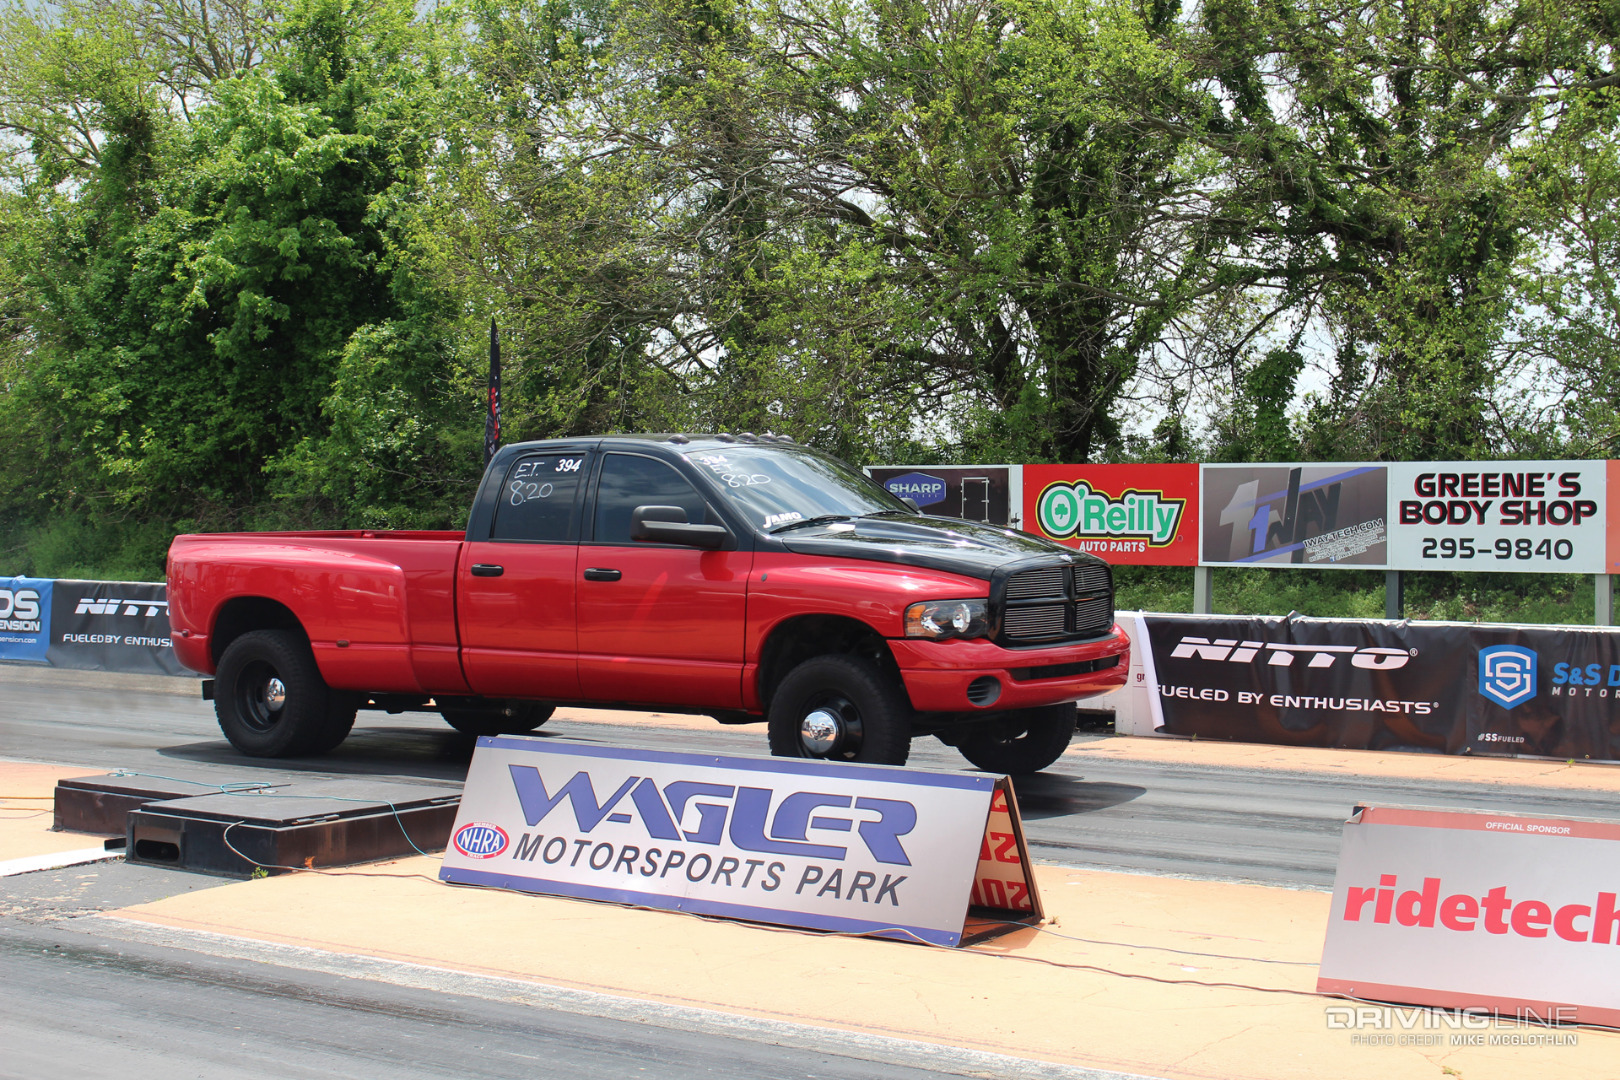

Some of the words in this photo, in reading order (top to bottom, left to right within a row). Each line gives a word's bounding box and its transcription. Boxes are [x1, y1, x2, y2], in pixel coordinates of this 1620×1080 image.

[555, 458, 583, 472] 394
[701, 454, 728, 465] 394
[510, 480, 553, 506] 8.20
[889, 483, 942, 493] SHARP
[1414, 472, 1582, 498] GREENE'S
[763, 511, 802, 529] JAMO
[1044, 488, 1175, 539] O'Reilly
[1399, 500, 1493, 525] BODY
[1500, 500, 1597, 526] SHOP
[1079, 541, 1107, 552] AUTO
[1110, 541, 1146, 552] PARTS
[1422, 537, 1574, 560] 295-9840
[75, 598, 170, 617] NITT
[63, 633, 104, 643] FUELED
[104, 634, 121, 644] BY
[1552, 662, 1602, 686] S&S
[1238, 691, 1263, 705] BY
[1270, 695, 1431, 714] ENTHUSIASTS
[508, 764, 917, 867] WAGLER
[1485, 821, 1524, 831] OFFICIAL
[1526, 824, 1571, 835] SPONSOR
[460, 828, 501, 853] NHRA
[512, 833, 786, 892] MOTORSPORTS
[795, 865, 908, 906] PARK
